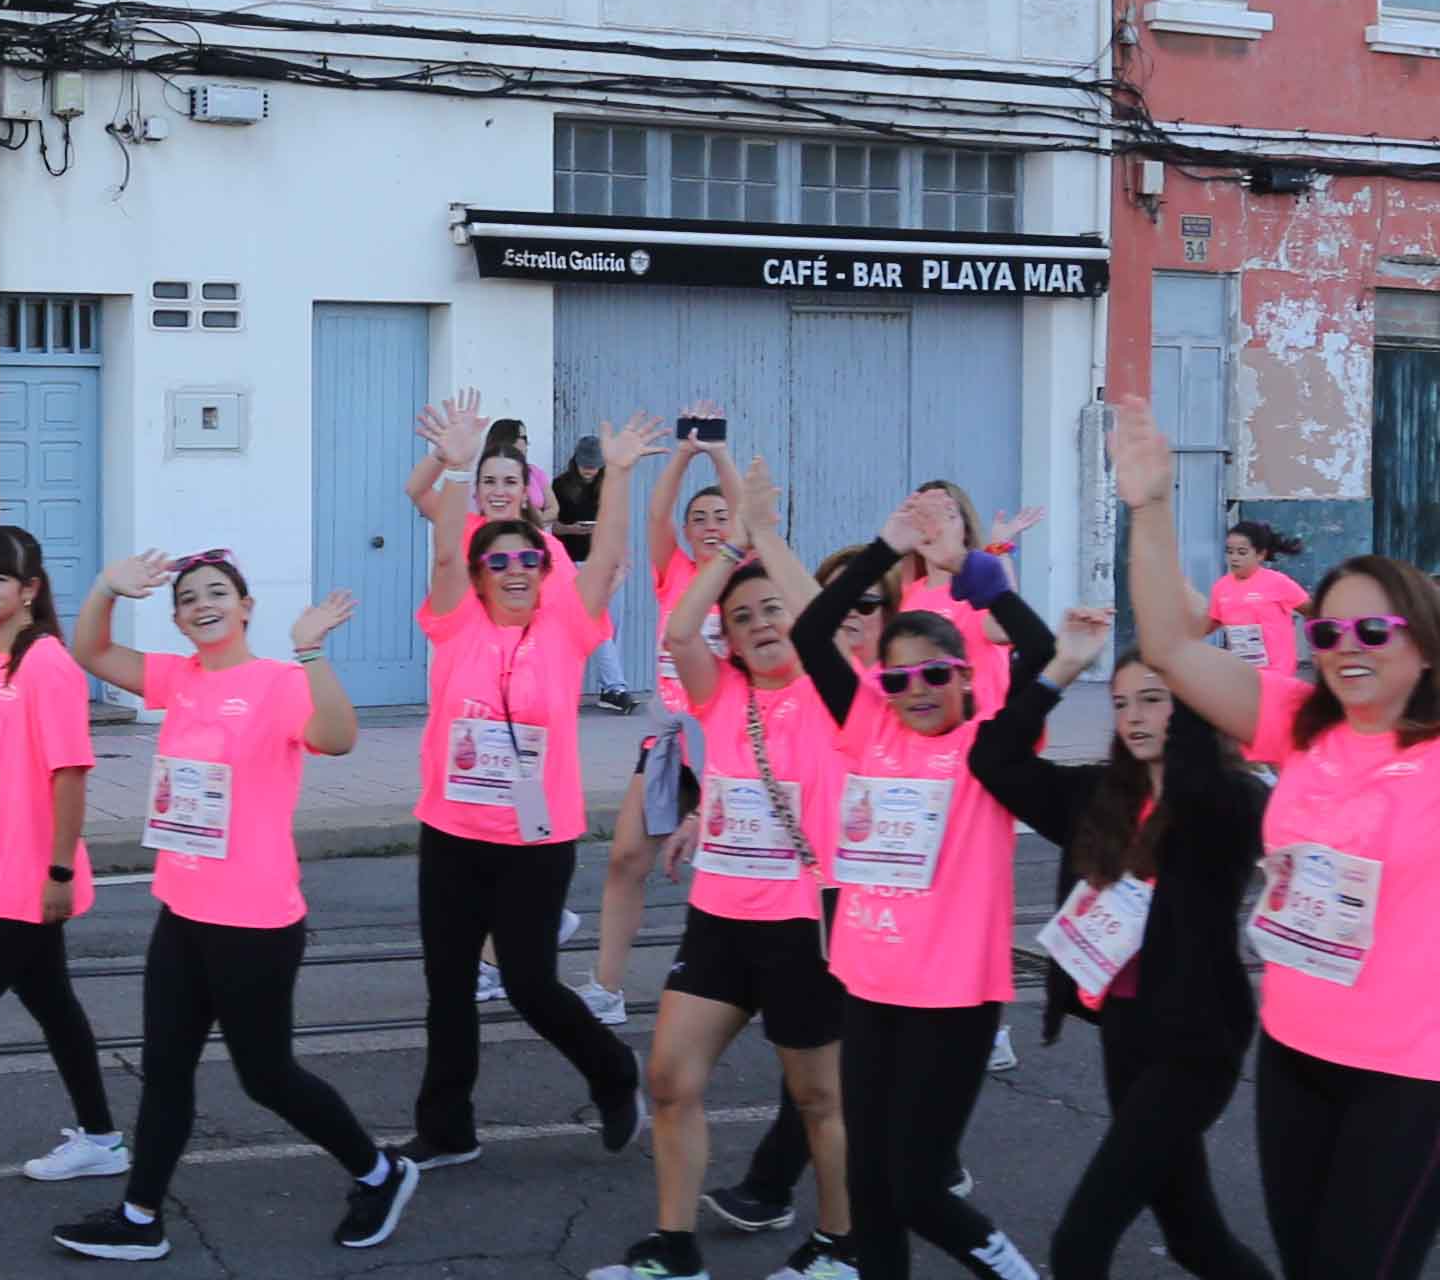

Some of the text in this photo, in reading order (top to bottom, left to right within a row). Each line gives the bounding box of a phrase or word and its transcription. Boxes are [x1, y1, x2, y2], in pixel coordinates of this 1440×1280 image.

[502, 249, 626, 272] Estrella Galicia
[763, 255, 828, 286] CAFÉ
[853, 261, 903, 288] BAR
[922, 260, 1016, 291] PLAYA
[1023, 263, 1085, 293] MAR
[480, 753, 513, 768] 016
[878, 820, 915, 839] 016
